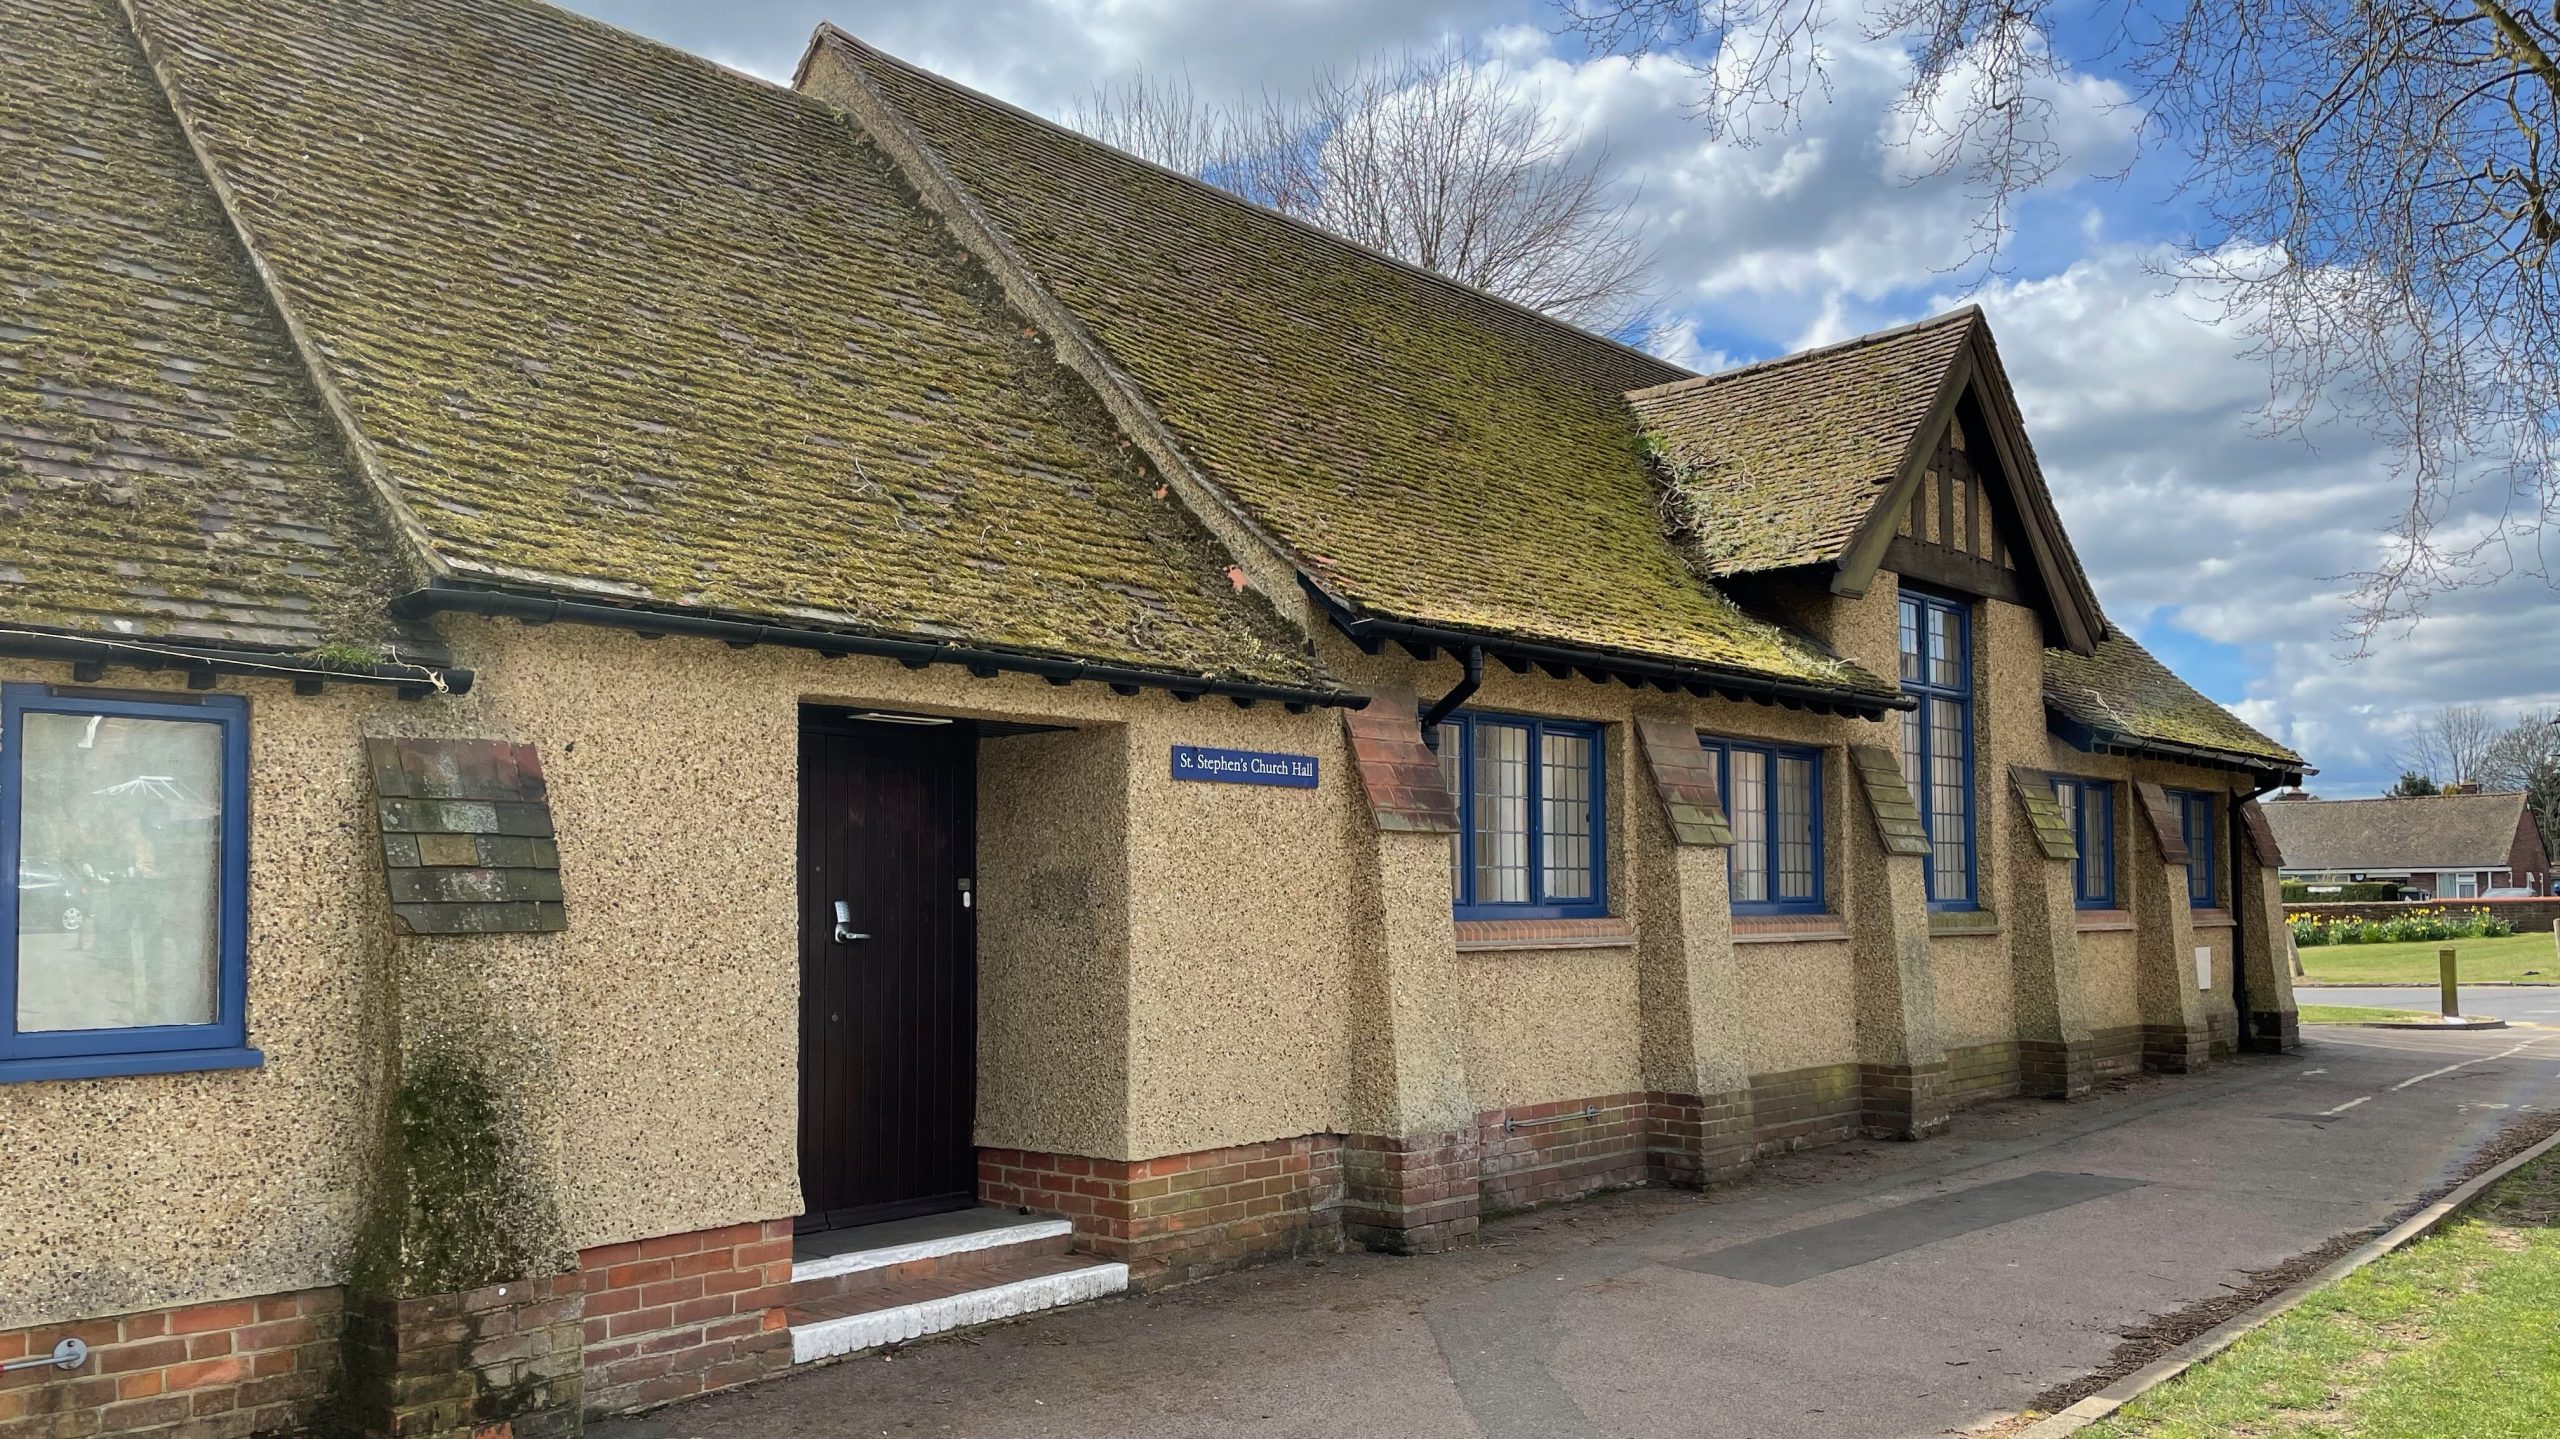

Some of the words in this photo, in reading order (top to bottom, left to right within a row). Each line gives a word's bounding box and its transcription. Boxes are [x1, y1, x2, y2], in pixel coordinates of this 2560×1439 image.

[1180, 752, 1194, 768] St.
[1197, 754, 1248, 774] Stephen's
[1251, 758, 1289, 775] Church
[1292, 762, 1313, 777] Hall
